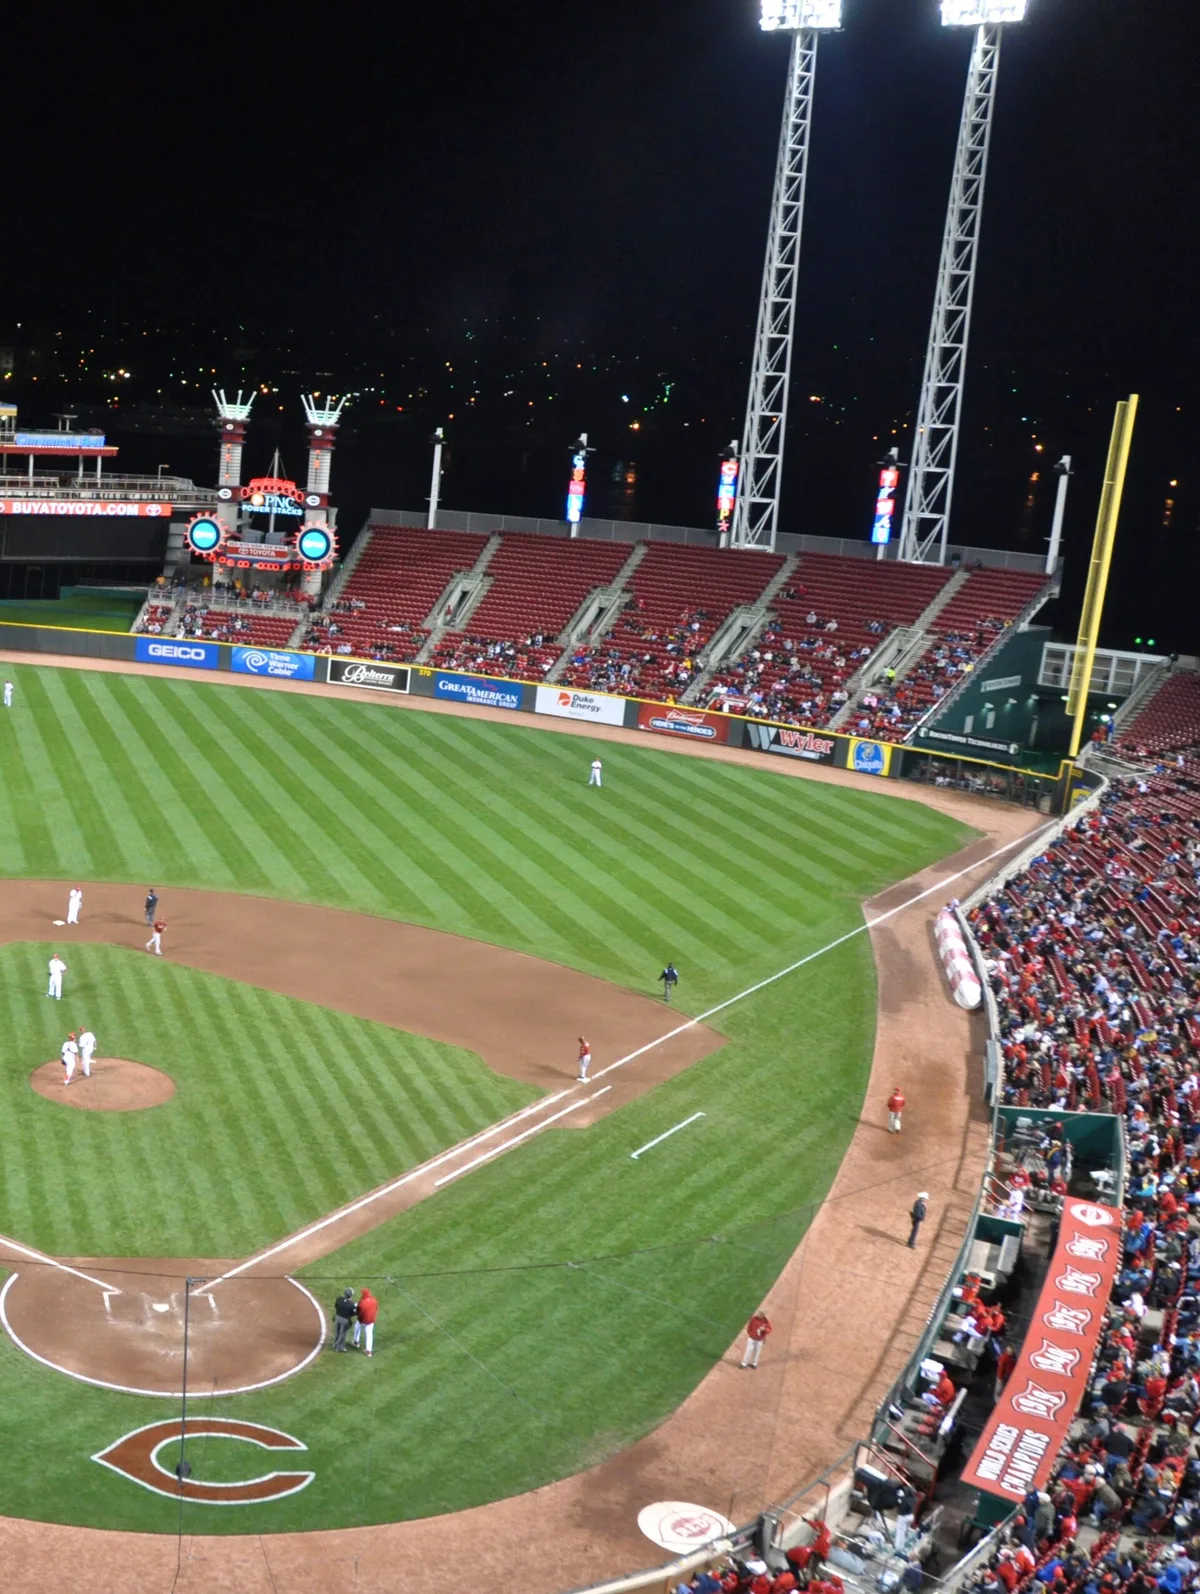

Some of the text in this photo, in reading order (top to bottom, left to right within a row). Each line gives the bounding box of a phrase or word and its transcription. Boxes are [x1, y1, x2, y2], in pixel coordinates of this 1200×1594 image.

[265, 495, 296, 508] PNC
[12, 502, 138, 516] BUYATOYOTA.COM
[242, 504, 303, 516] POWER STACKS
[250, 549, 276, 557] TOYOTA
[148, 644, 206, 661] GEICO
[270, 652, 290, 662] Time
[268, 659, 299, 670] Warner
[268, 667, 292, 676] Cable
[341, 664, 395, 683] Belterra
[418, 669, 431, 677] 370
[439, 680, 518, 702] GREAT AMERICAN
[466, 696, 517, 709] INSURANCE GROUP
[573, 694, 594, 704] Duke
[570, 701, 600, 713] Energy
[652, 719, 714, 737] HERE'S HEROES
[779, 729, 834, 753] Wyler
[855, 760, 883, 771] Chiquita
[1048, 1307, 1087, 1331] 1975
[1034, 1347, 1075, 1373] 1940
[1018, 1389, 1061, 1416] 1919
[975, 1423, 1020, 1481] WORLD SERIES
[1000, 1428, 1050, 1496] CHAMPIONS
